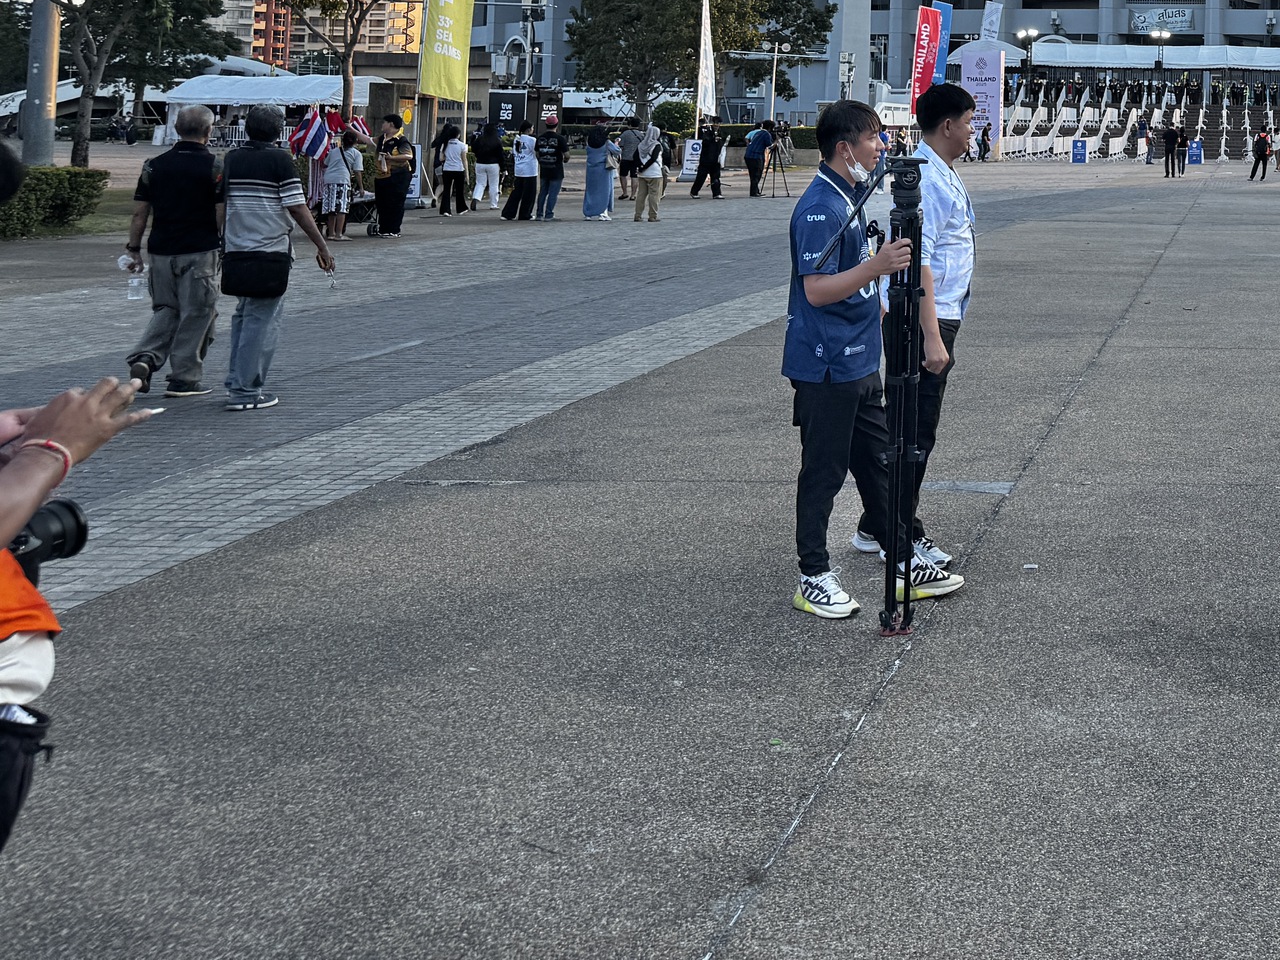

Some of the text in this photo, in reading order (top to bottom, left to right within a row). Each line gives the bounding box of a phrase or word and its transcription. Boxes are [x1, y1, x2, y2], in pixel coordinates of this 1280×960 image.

[1158, 9, 1186, 21] สโมสร
[915, 23, 931, 79] THAILAND
[501, 102, 513, 110] true
[543, 103, 558, 111] true
[500, 110, 513, 120] 5G
[807, 214, 826, 222] true
